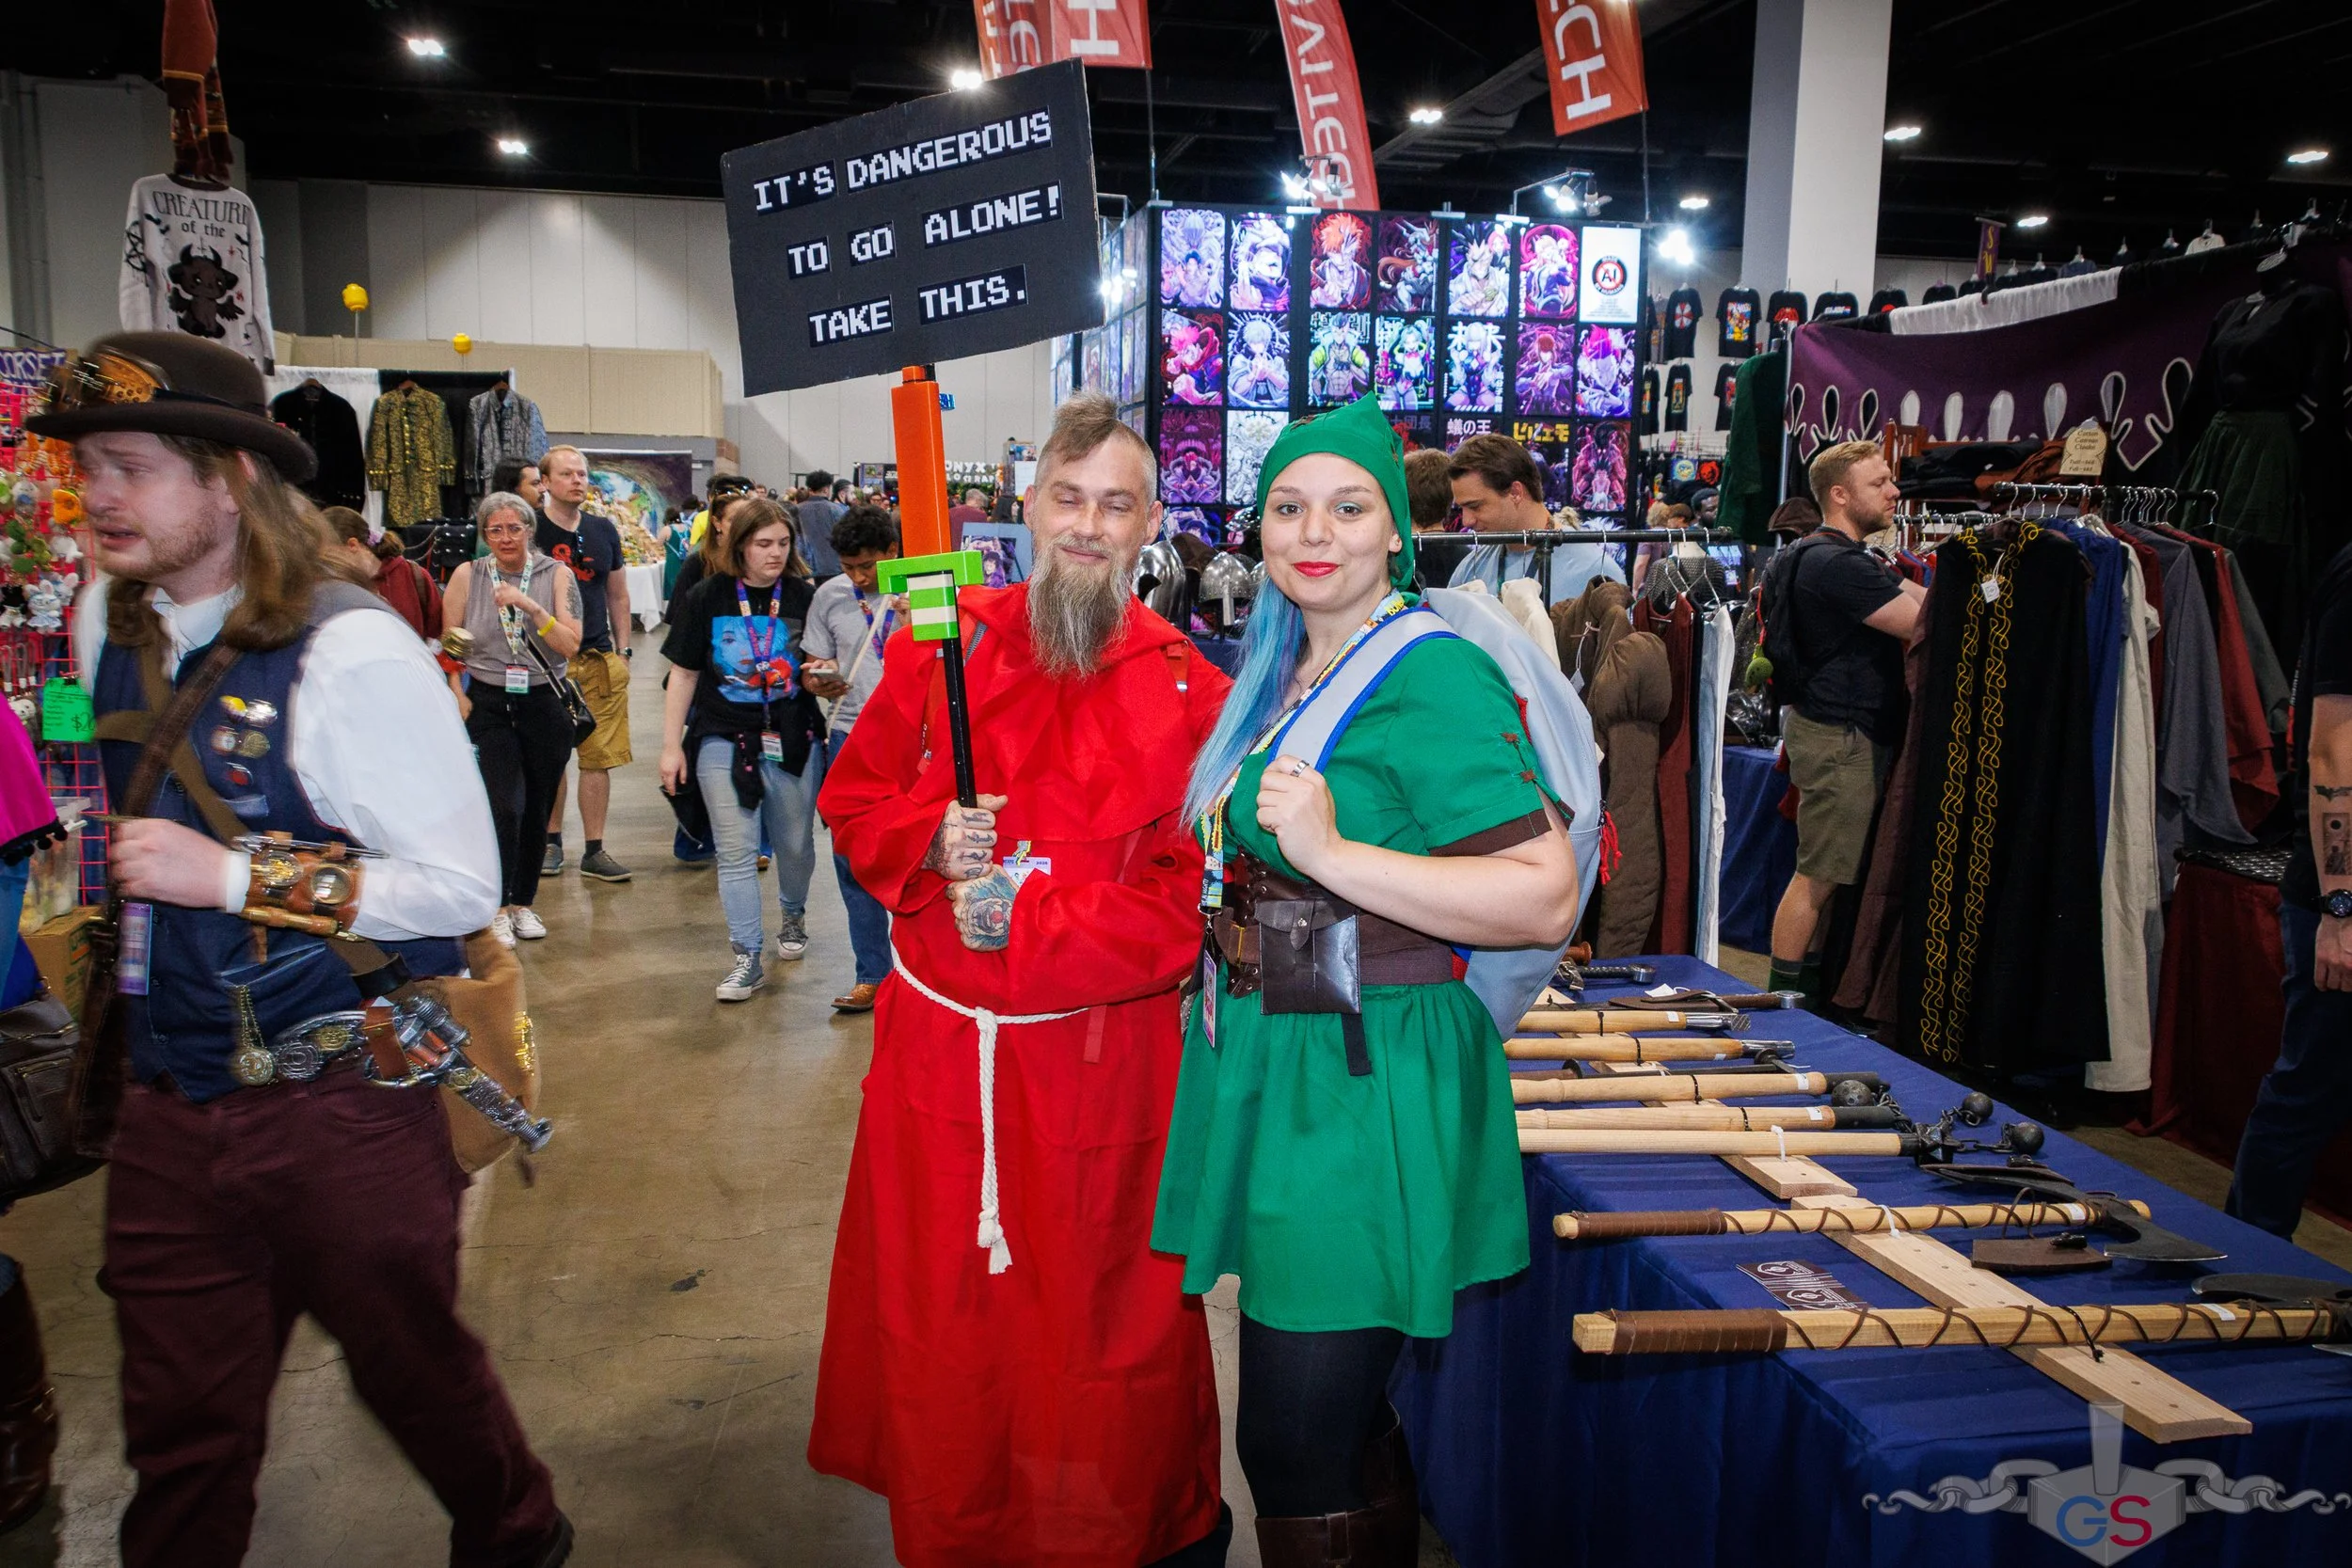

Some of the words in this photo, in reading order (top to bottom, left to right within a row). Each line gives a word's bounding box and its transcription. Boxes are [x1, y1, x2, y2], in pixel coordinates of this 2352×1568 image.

[754, 166, 835, 212] IT'S
[847, 111, 1052, 189] DANGEROUS
[182, 221, 196, 234] of
[204, 223, 226, 238] the
[788, 242, 829, 274] TO
[851, 227, 894, 261] GO
[925, 185, 1059, 244] ALONE!
[1601, 268, 1617, 283] AI
[810, 300, 892, 342] TAKE
[919, 276, 1025, 319] THIS.
